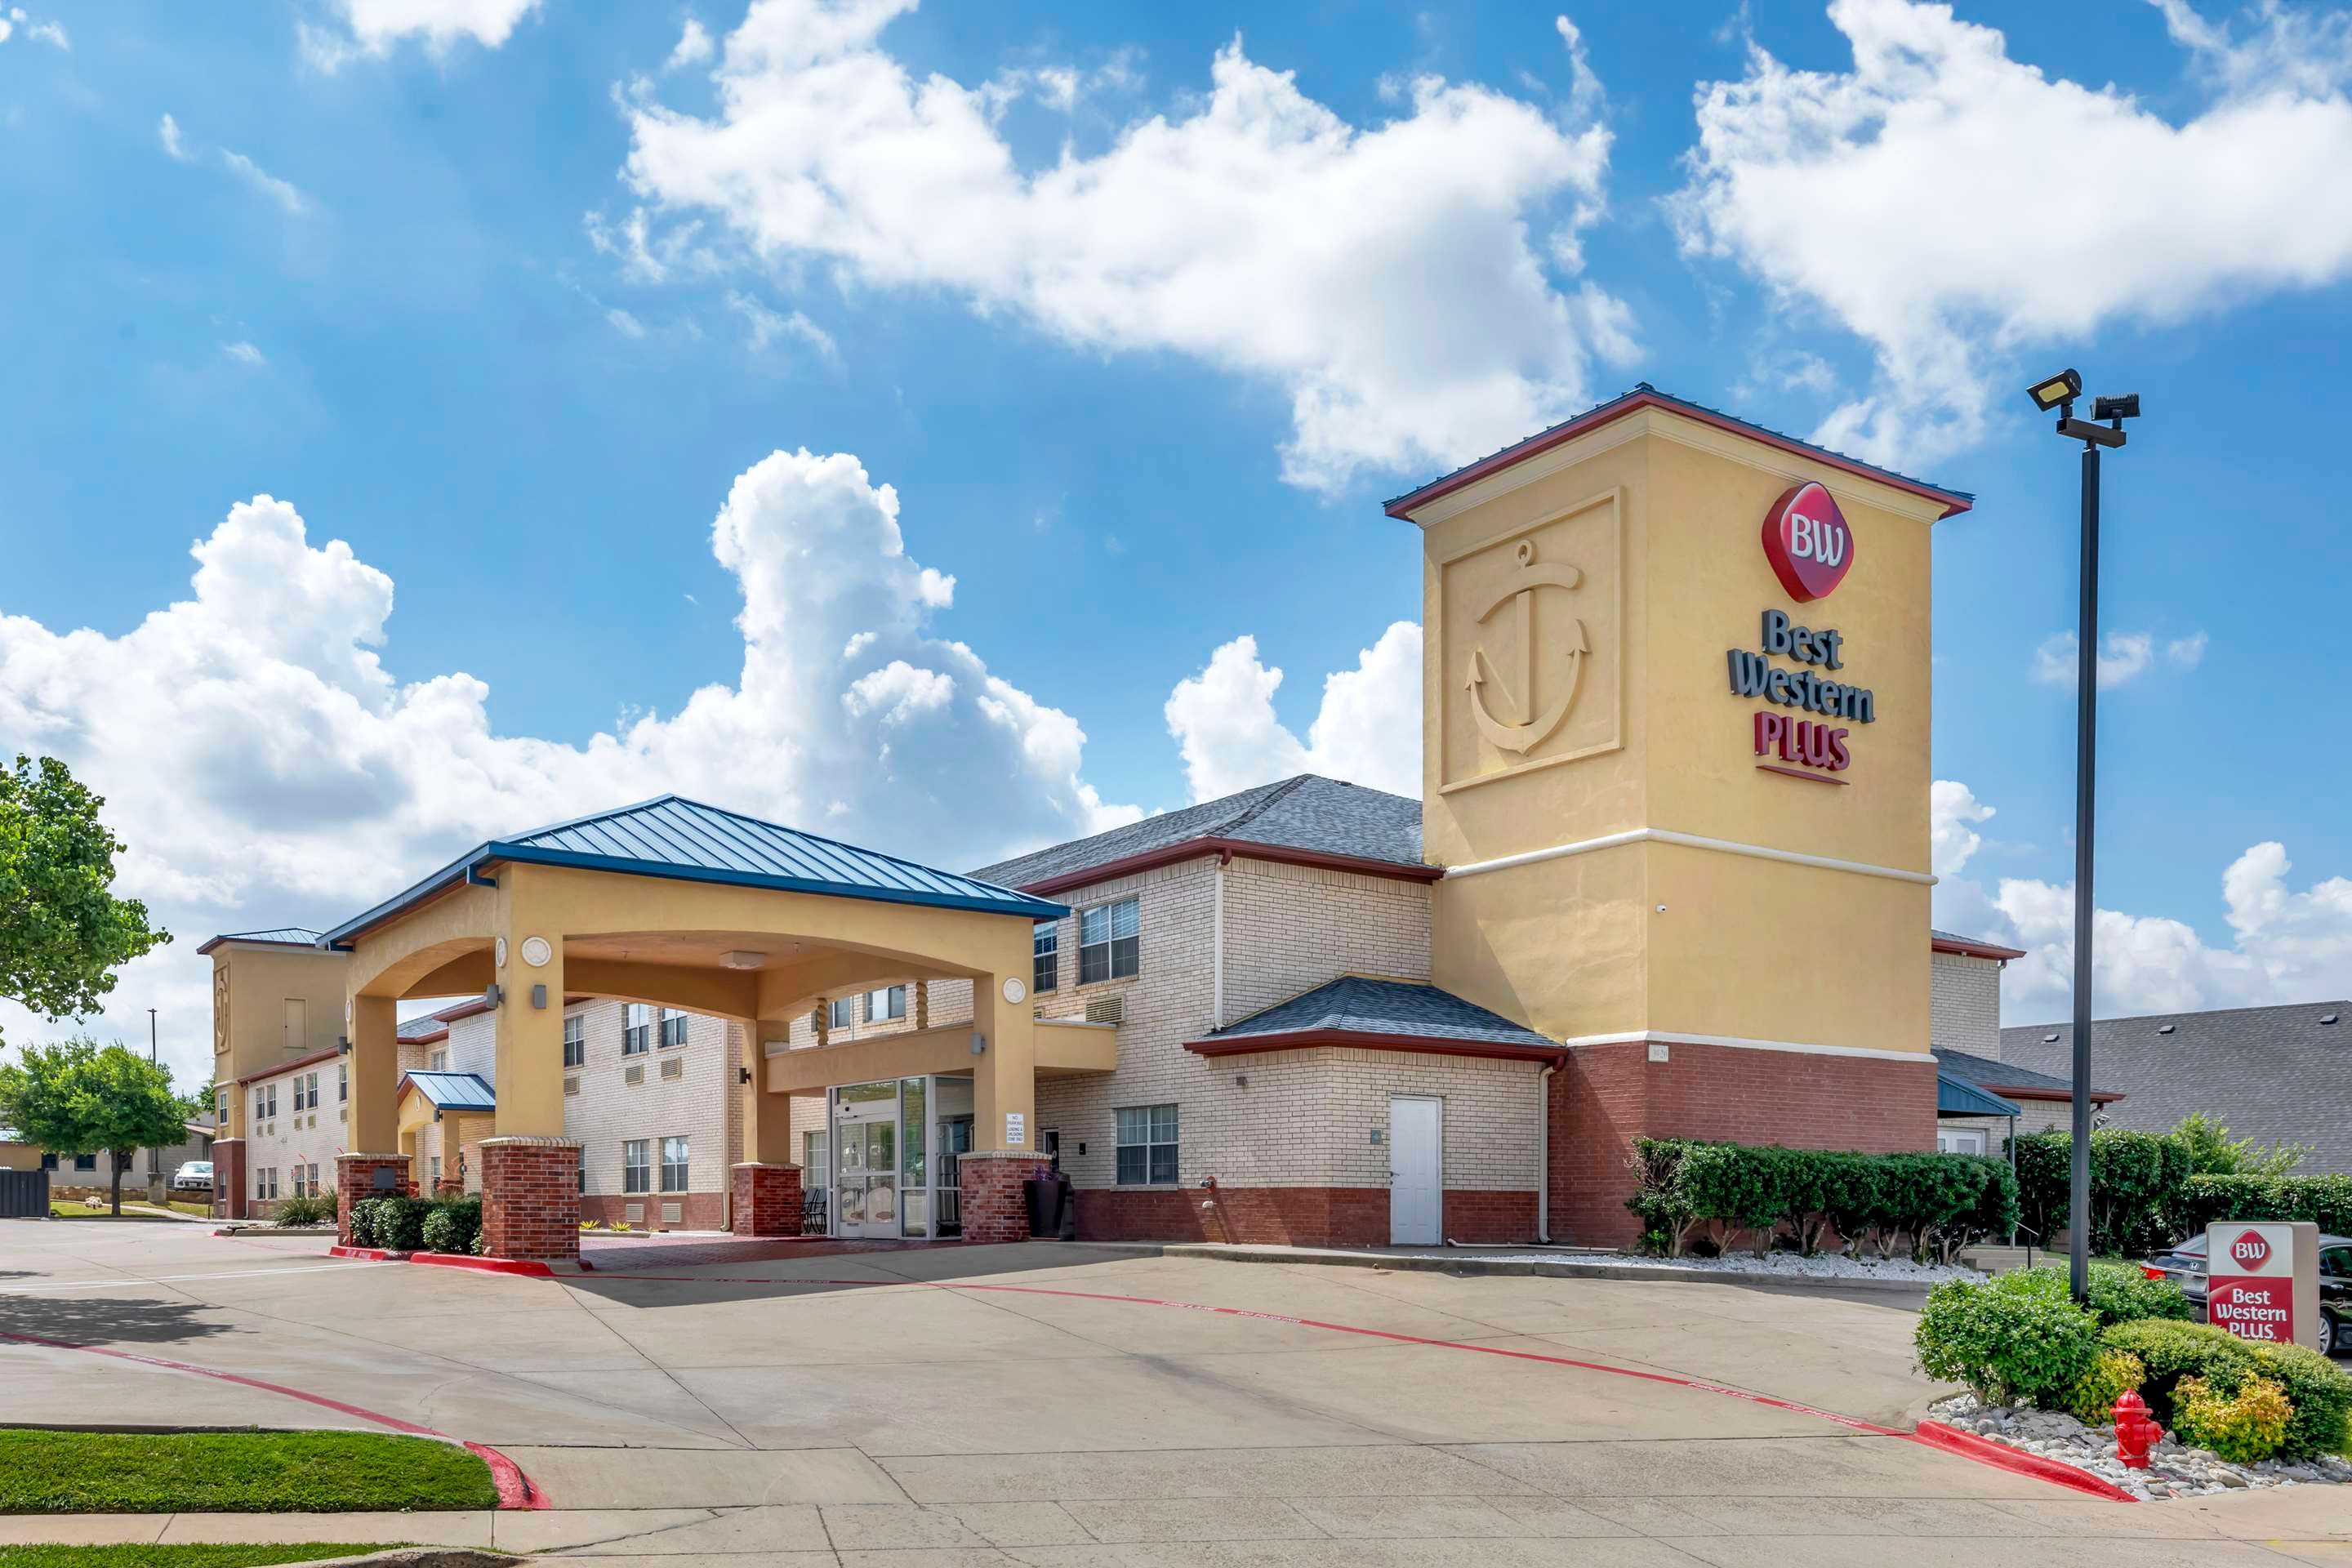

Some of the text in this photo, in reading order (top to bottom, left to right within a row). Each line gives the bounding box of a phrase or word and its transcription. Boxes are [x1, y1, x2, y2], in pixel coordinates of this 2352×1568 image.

[1791, 513, 1844, 568] BW
[1762, 609, 1843, 670] Best
[1727, 648, 1875, 724] Western
[1754, 711, 1850, 771] PLUS
[2235, 1242, 2266, 1258] BW
[2216, 1303, 2287, 1321] Western
[2232, 1288, 2270, 1304] Best
